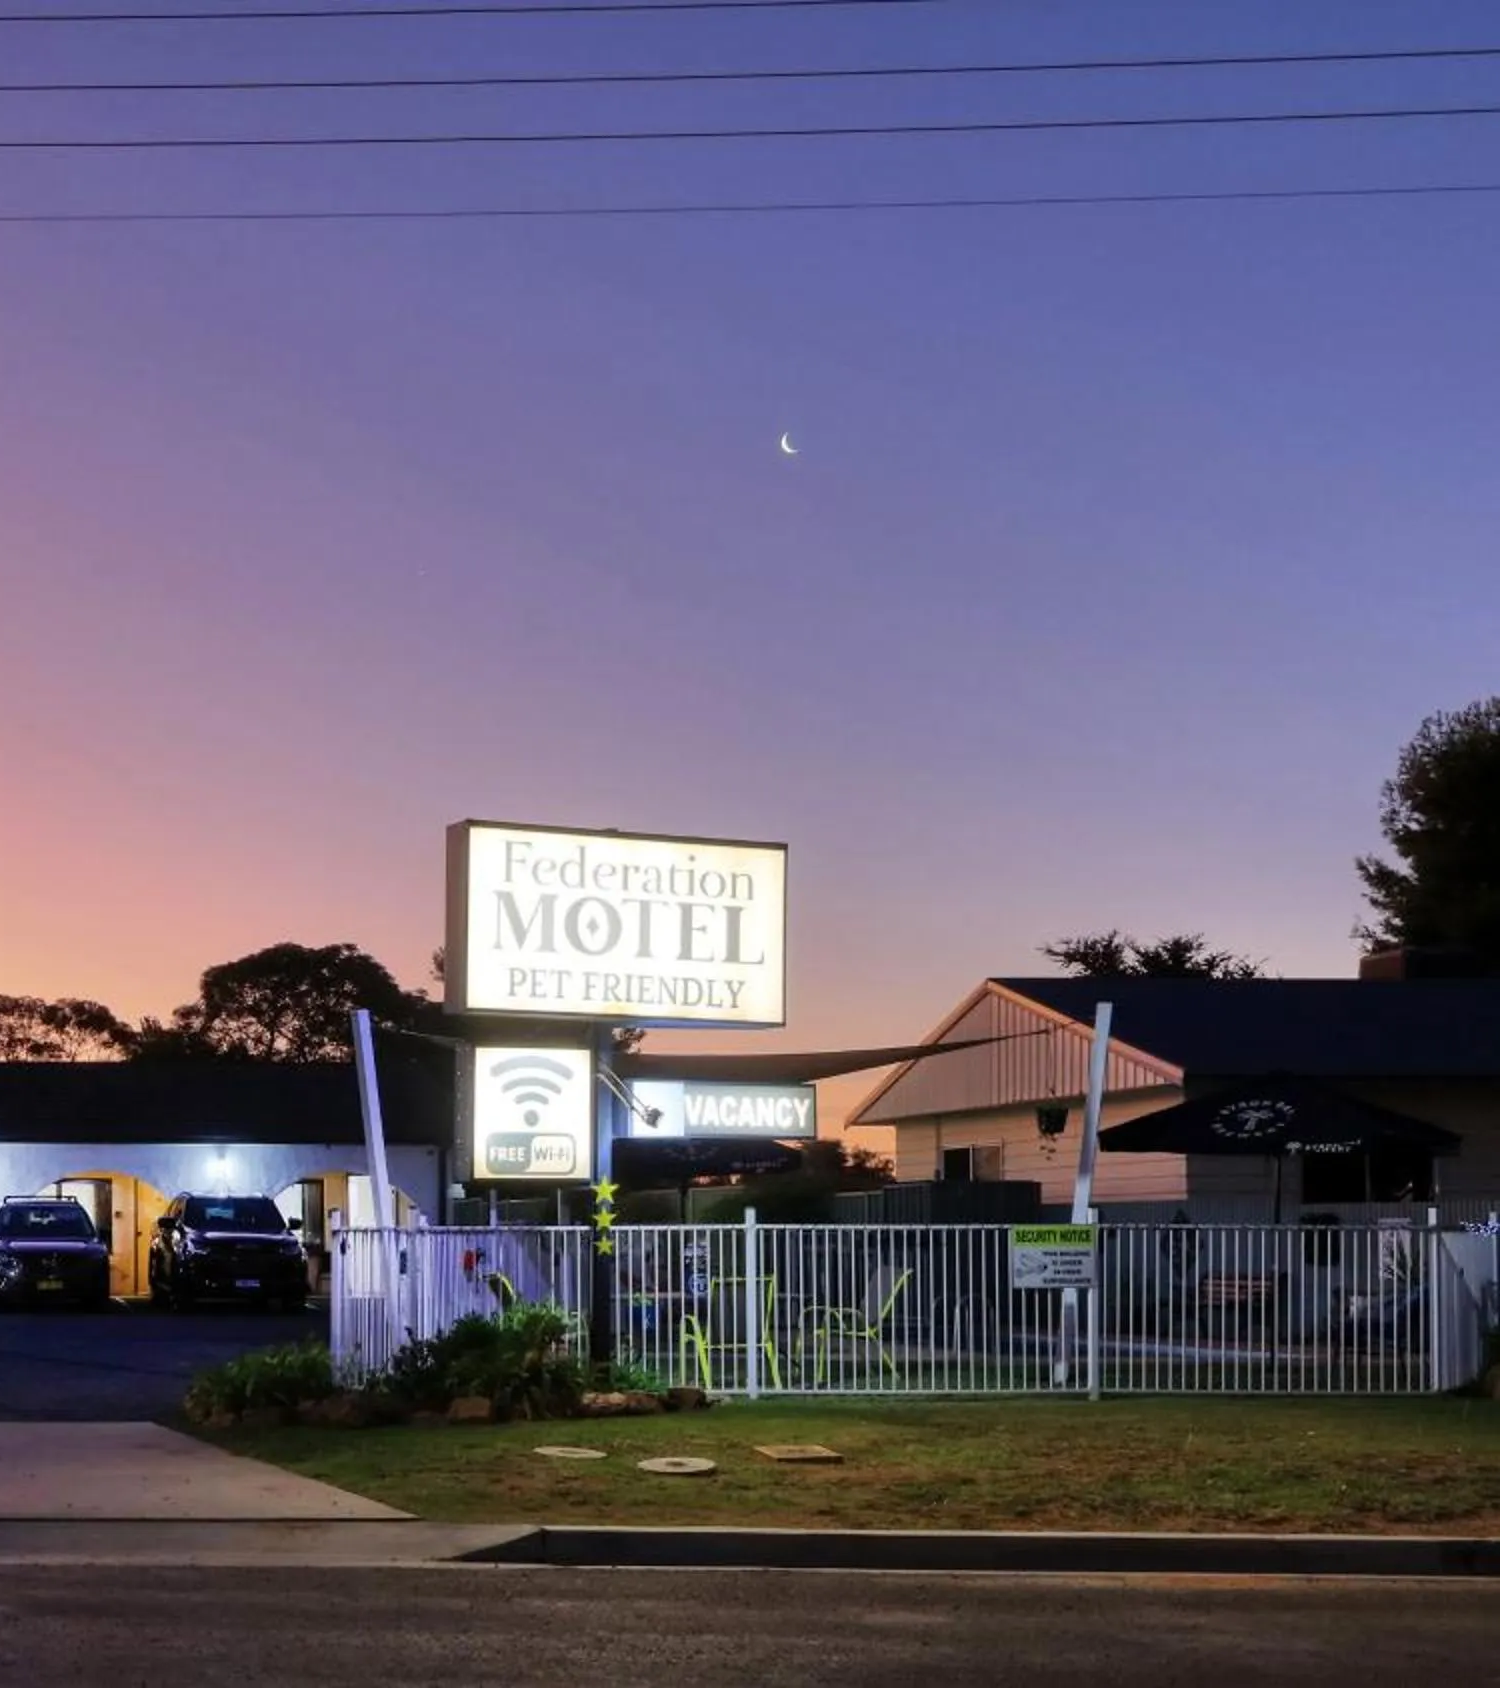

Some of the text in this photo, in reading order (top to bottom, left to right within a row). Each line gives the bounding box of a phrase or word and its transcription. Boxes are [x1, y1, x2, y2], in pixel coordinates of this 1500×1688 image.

[502, 839, 755, 901] Federation
[492, 889, 765, 966] MOTEL
[507, 967, 747, 1010] PET FRIENDLY
[683, 1094, 812, 1129] VACANCY
[489, 1145, 527, 1161] FREE
[1015, 1229, 1091, 1243] SECURITY NOTICE
